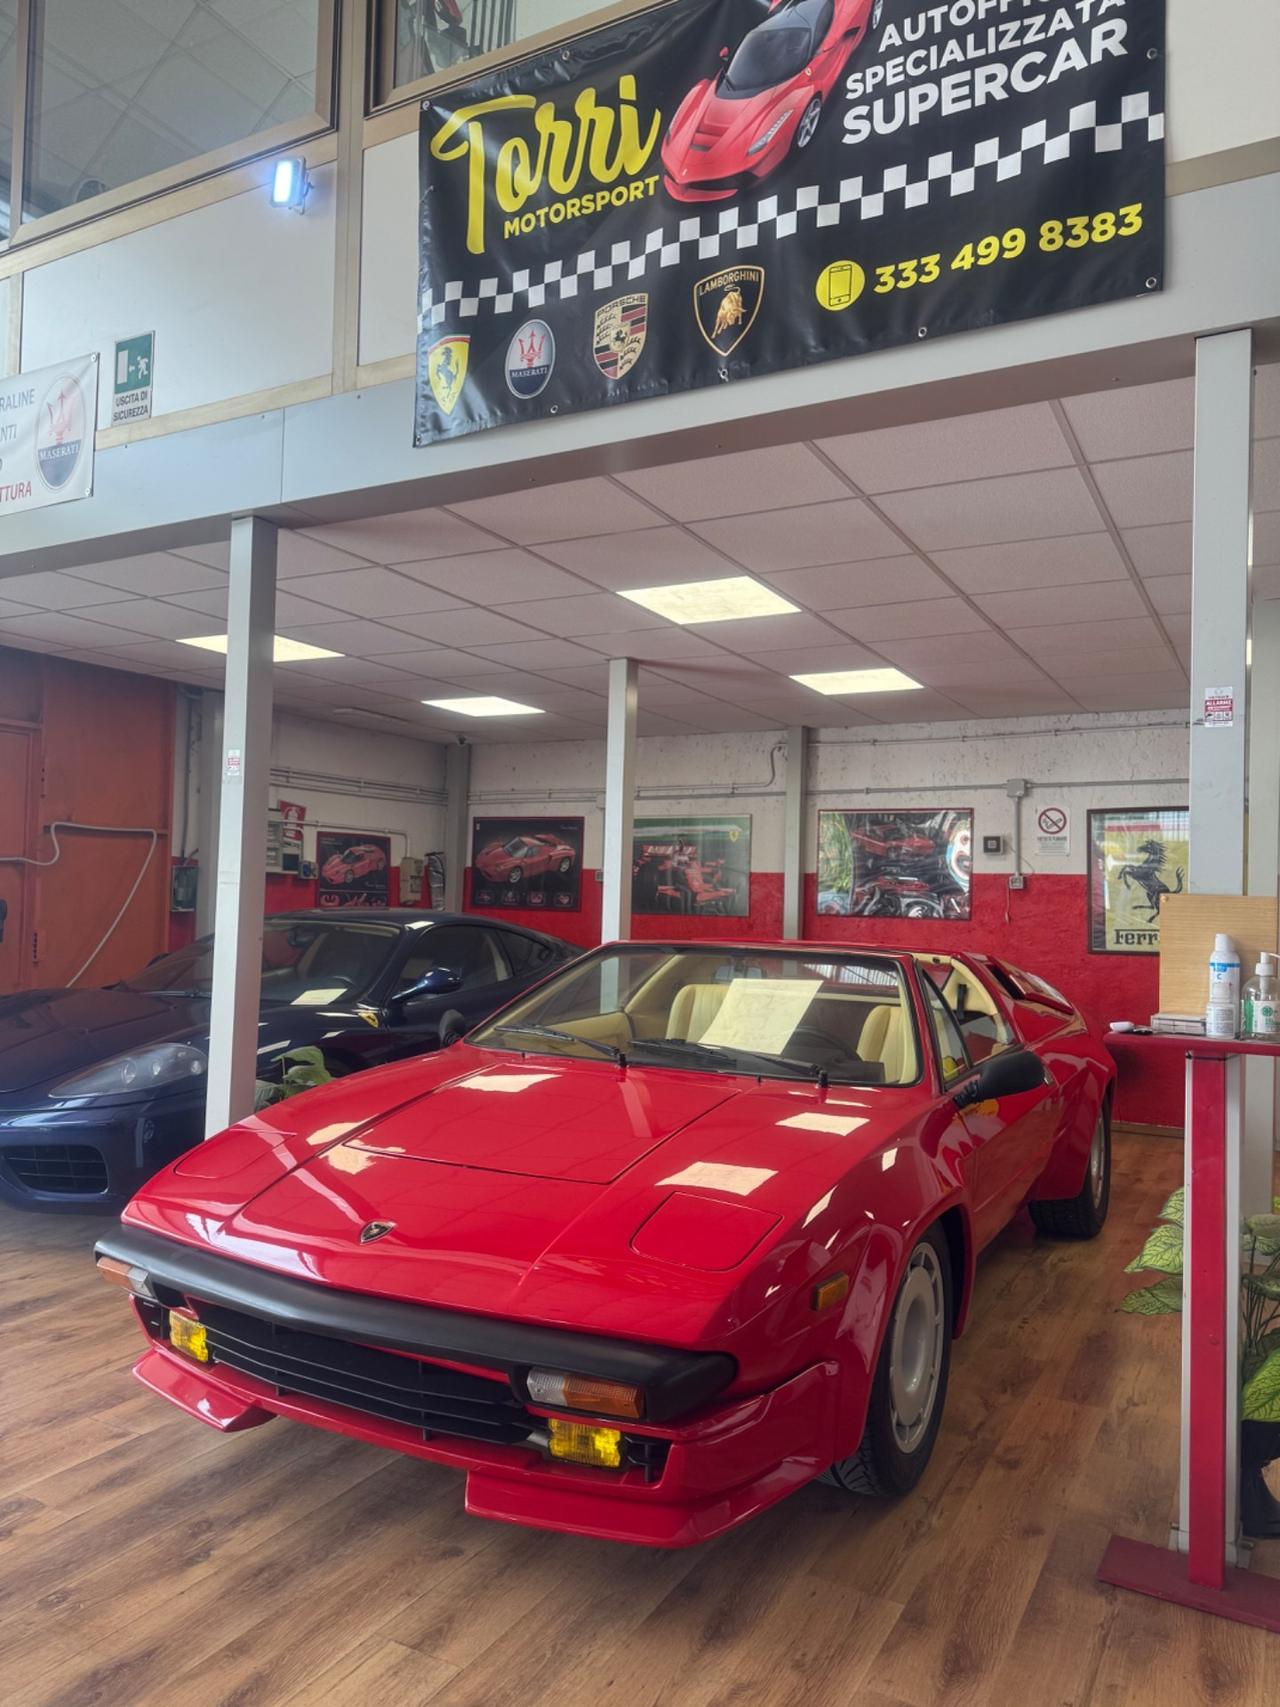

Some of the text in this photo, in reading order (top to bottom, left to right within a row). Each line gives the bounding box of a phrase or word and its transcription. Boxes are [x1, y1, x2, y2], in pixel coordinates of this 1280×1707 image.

[878, 0, 1048, 52] AUTOF
[846, 0, 1126, 99] SPECIALIZZATA
[842, 18, 1128, 145] SUPERCAR
[431, 75, 661, 254] Torri
[504, 175, 660, 239] MOTORSPORT
[873, 203, 1143, 293] 333 499 8383
[700, 270, 760, 296] LAMBORGHINI
[597, 294, 646, 318] PORSCHE
[511, 366, 548, 378] MASERATI
[115, 390, 148, 407] USCITA DI
[113, 404, 149, 421] SICUREZZA
[40, 443, 79, 460] MASERATI
[1113, 929, 1159, 945] Ferr
